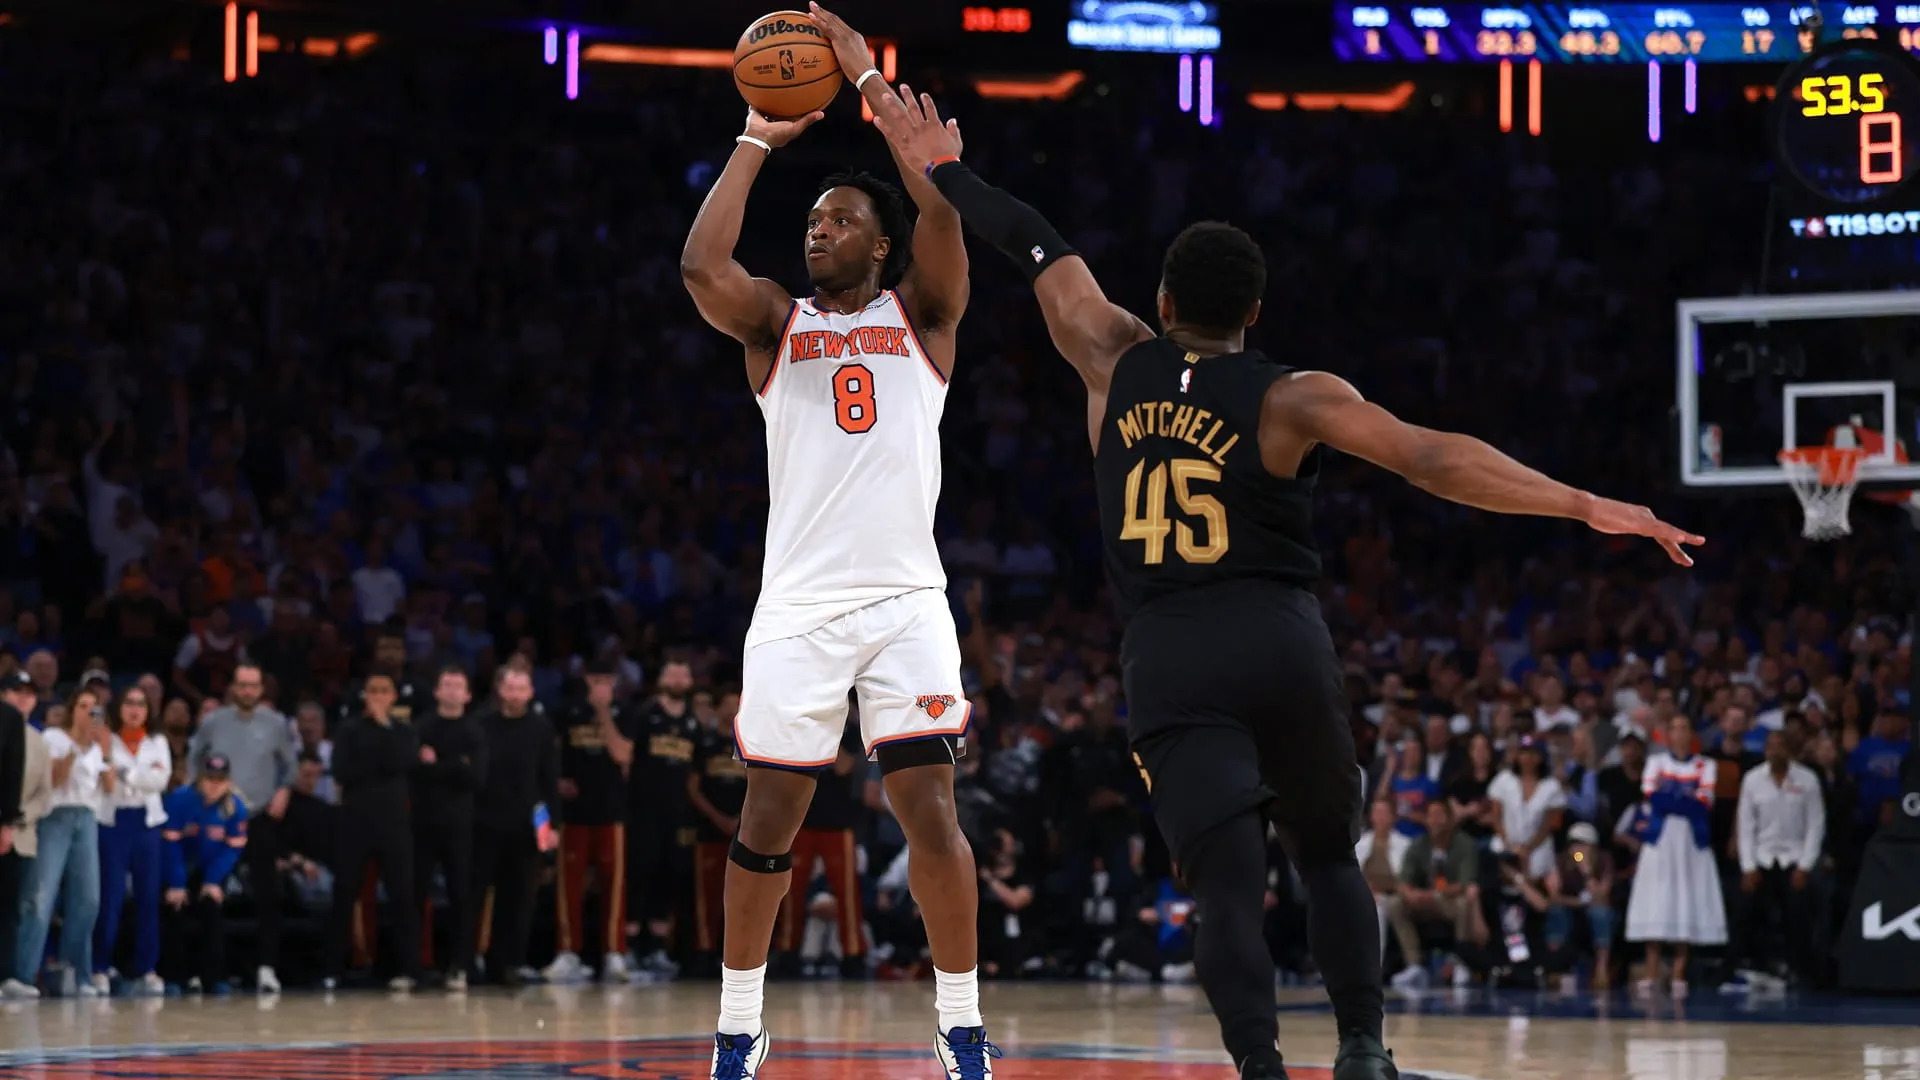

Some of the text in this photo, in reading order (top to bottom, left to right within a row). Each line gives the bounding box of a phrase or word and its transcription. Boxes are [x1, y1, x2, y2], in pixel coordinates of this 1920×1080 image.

[748, 19, 824, 44] Wilson
[1801, 73, 1884, 117] 53.5
[1860, 111, 1902, 184] 8
[1825, 210, 1920, 236] TISSOT
[790, 326, 910, 364] NEW YORK
[832, 363, 878, 434] 8
[1117, 401, 1240, 466] MITCHELL
[1119, 457, 1229, 564] 45
